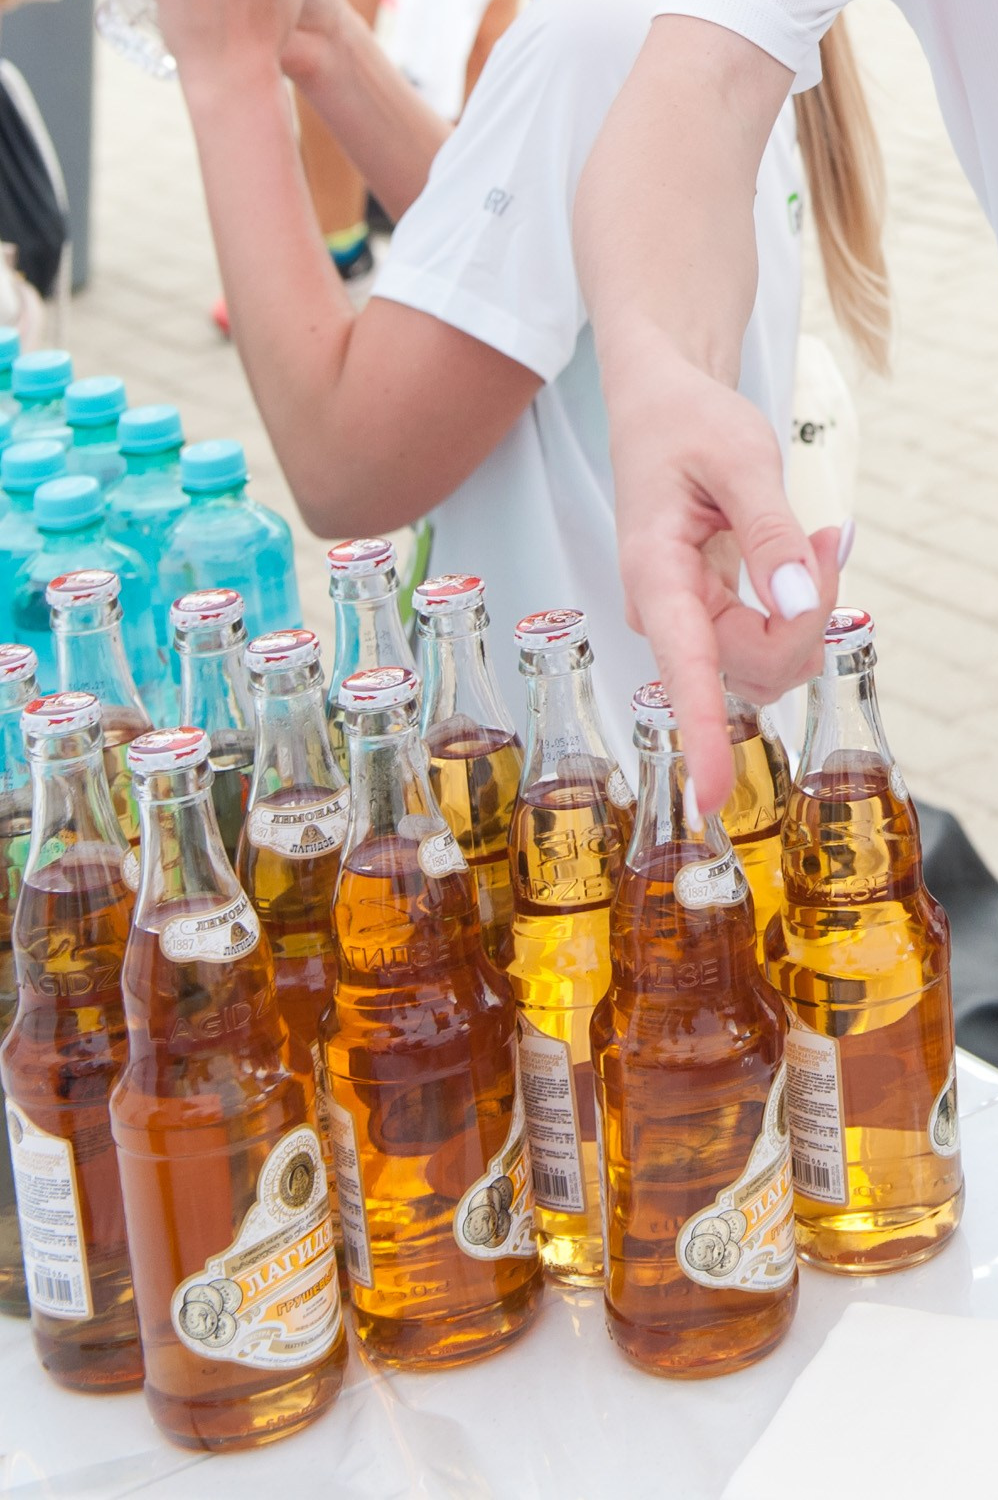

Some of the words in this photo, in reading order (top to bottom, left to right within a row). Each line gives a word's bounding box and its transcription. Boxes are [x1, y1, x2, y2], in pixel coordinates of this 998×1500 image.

[688, 885, 708, 899] 1887
[194, 898, 250, 933] ЛИМОНА
[171, 937, 195, 952] 1887
[146, 987, 277, 1044] LAGIDZ
[247, 1225, 332, 1297] ЛАГИДЗ
